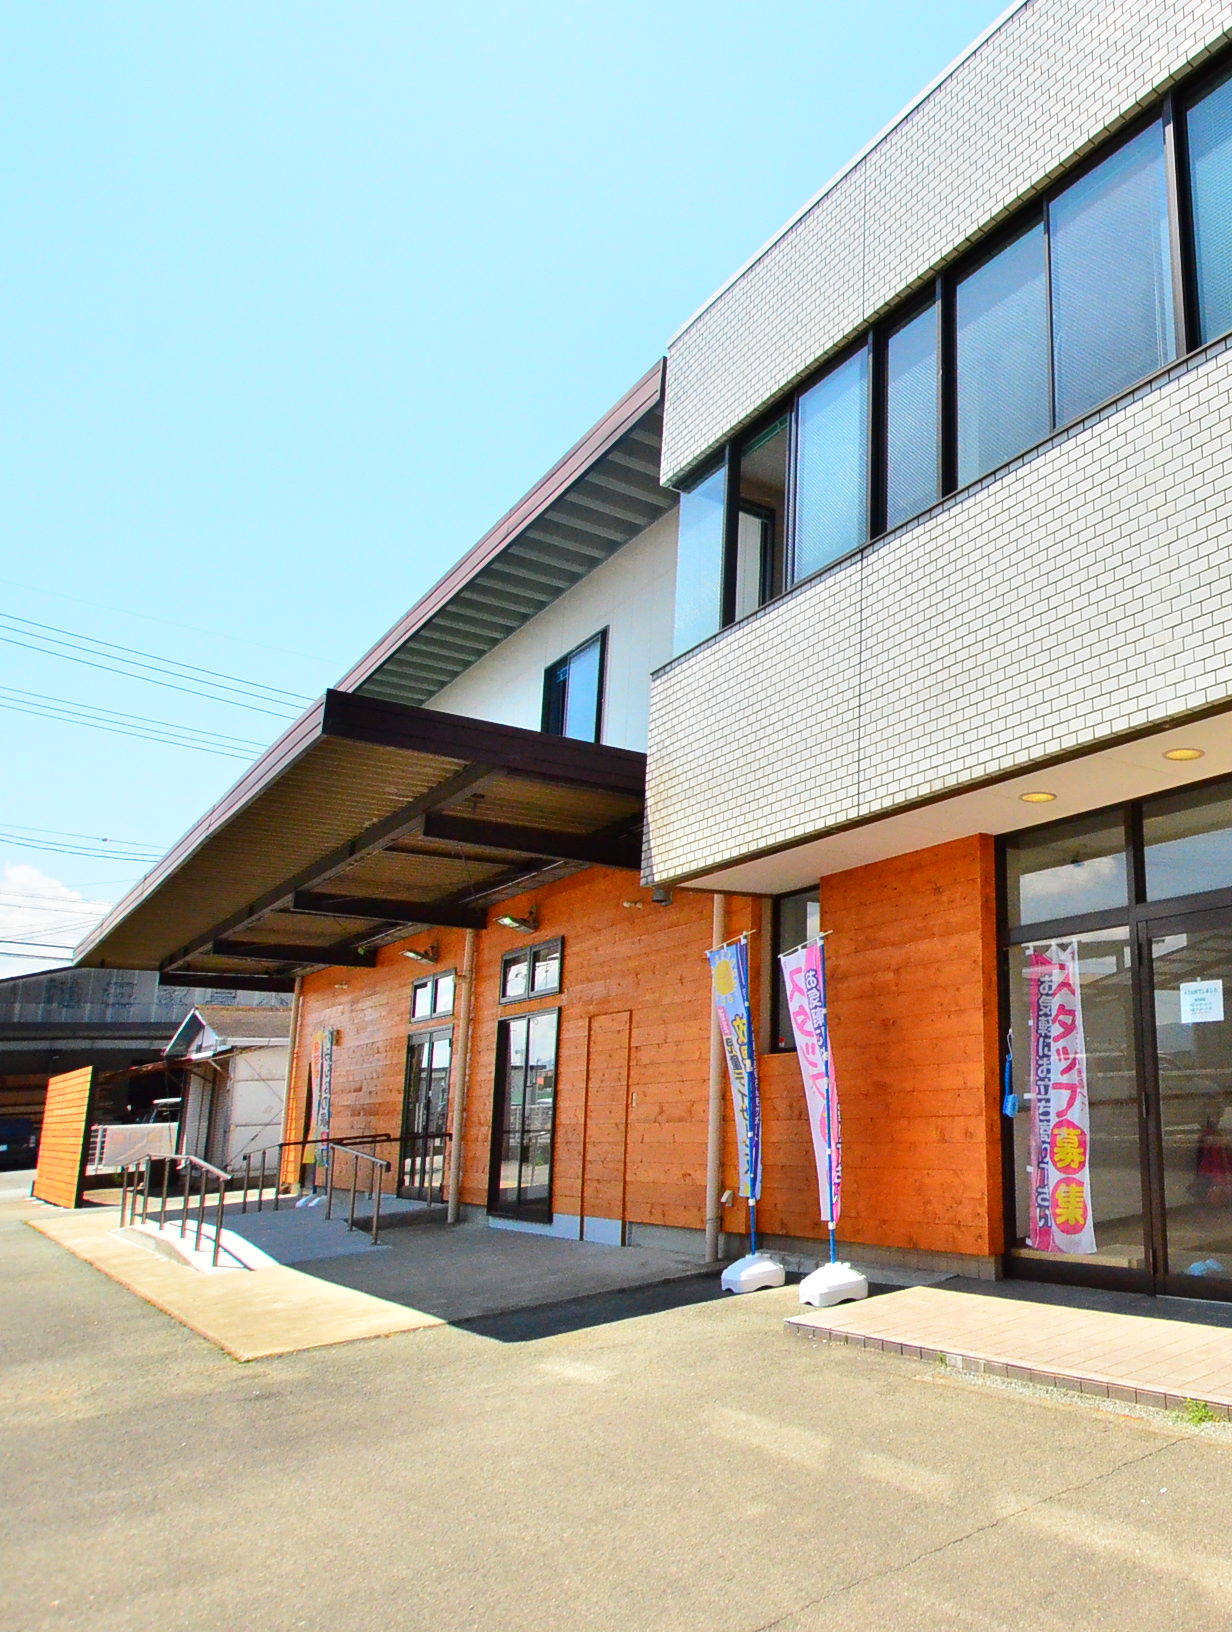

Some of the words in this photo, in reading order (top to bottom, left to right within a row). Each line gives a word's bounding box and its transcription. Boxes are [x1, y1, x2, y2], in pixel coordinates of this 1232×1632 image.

[1051, 962, 1087, 1228] スタッフ募集
